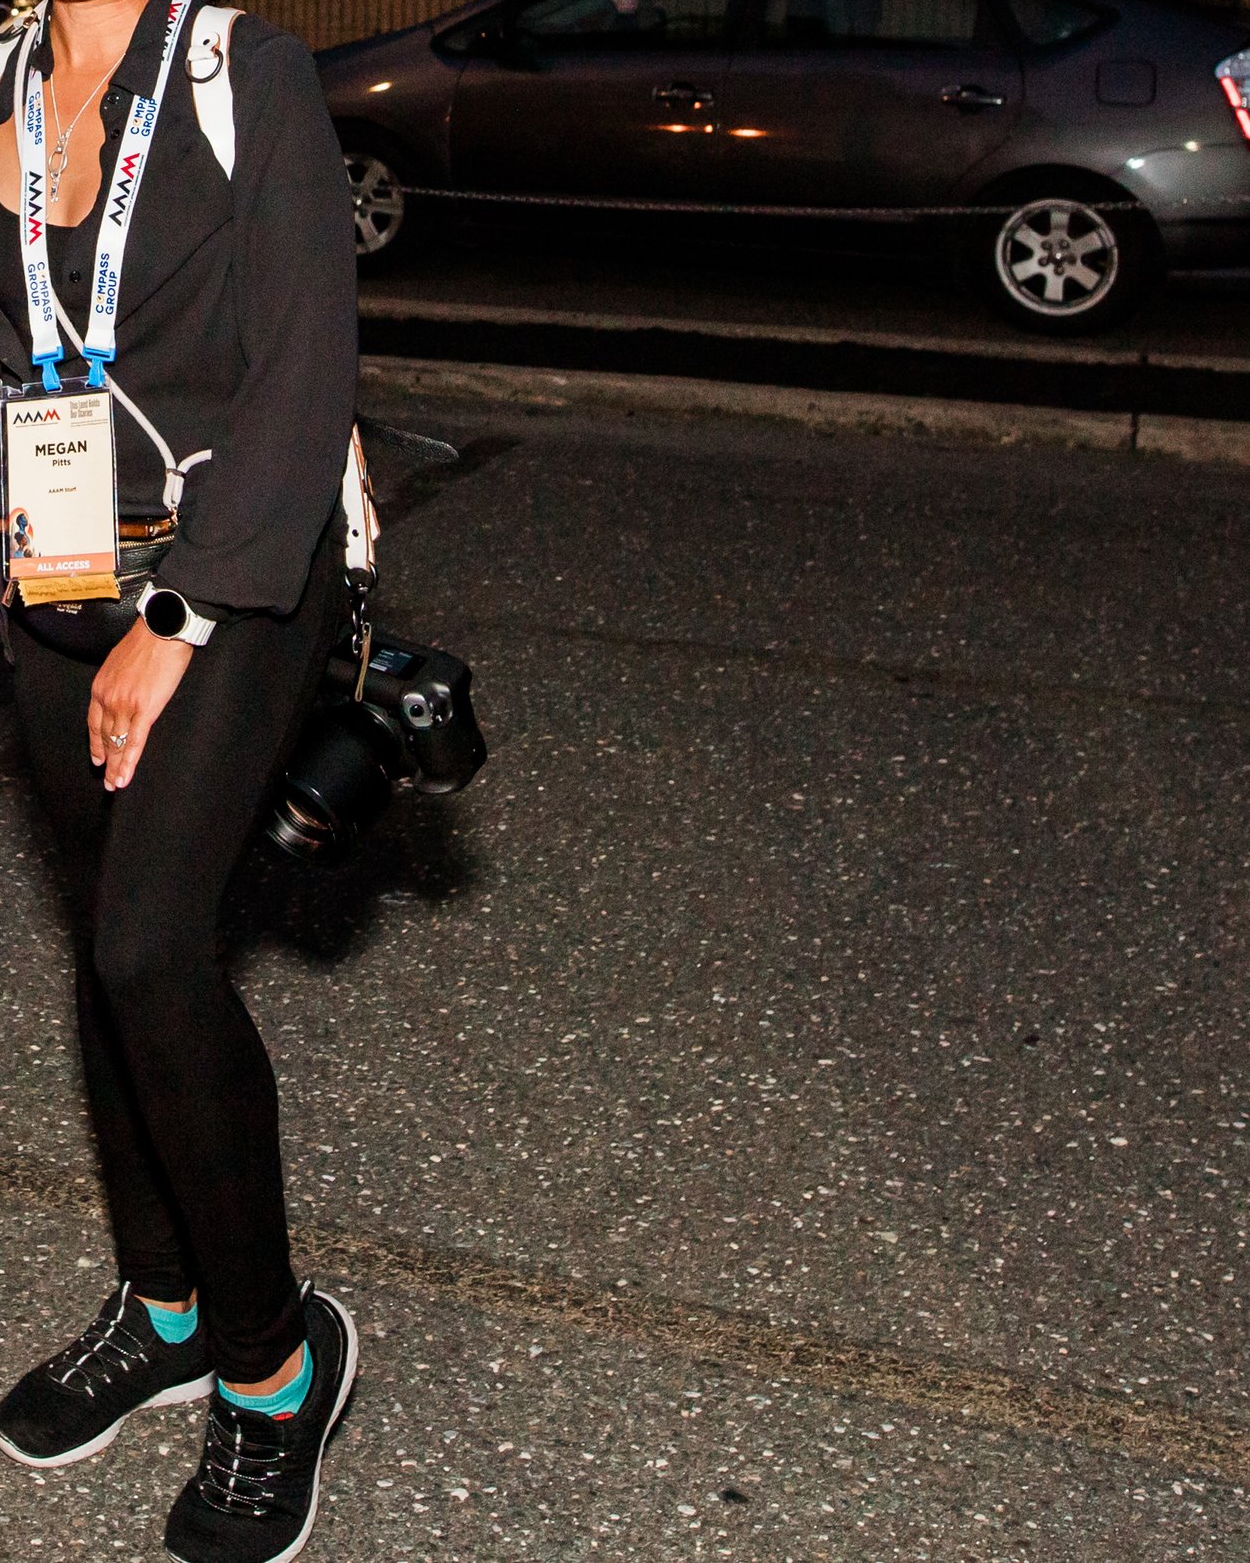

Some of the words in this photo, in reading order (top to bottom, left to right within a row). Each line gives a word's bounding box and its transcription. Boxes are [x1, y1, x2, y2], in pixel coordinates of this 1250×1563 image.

[27, 95, 35, 133] GROUP
[141, 98, 157, 137] GROUP
[27, 264, 40, 306] GROUP
[95, 253, 110, 314] COMPASS
[105, 271, 118, 315] GROUP
[35, 440, 87, 457] MEGAN
[52, 459, 71, 467] Pitts
[37, 562, 54, 572] ALL
[55, 560, 91, 571] ACCESS
